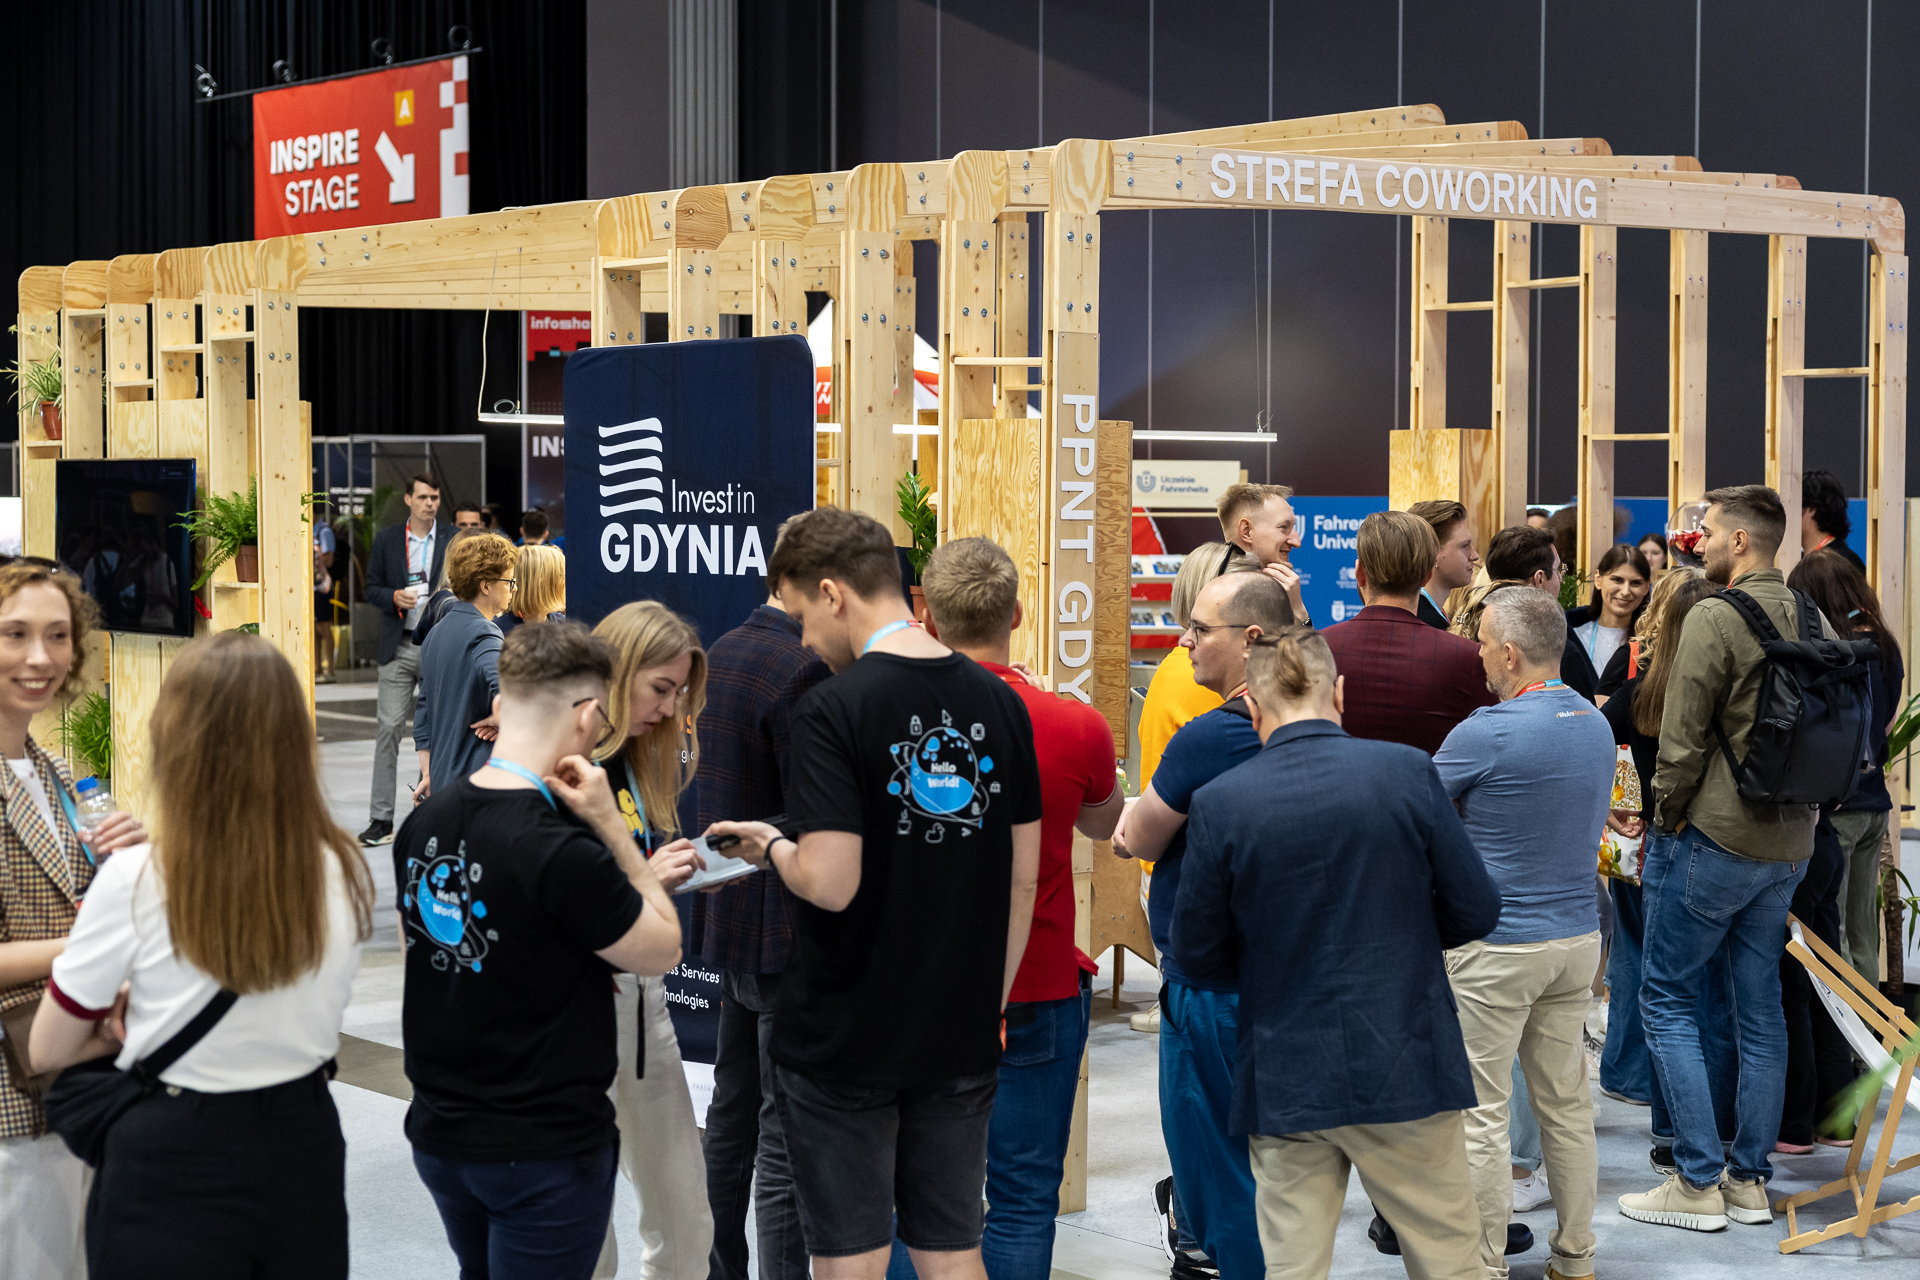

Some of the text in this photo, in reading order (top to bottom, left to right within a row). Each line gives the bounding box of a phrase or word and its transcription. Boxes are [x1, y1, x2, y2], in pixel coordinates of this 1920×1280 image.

[270, 128, 359, 175] INSPIRE
[285, 173, 359, 216] STAGE
[1210, 153, 1598, 219] STREFA COWORKING
[532, 435, 564, 457] IN
[672, 478, 755, 514] Invest in
[1060, 394, 1096, 564] PPNT
[600, 522, 768, 577] GDYNIA
[927, 777, 960, 789] World!
[931, 761, 957, 773] Hello
[681, 963, 720, 984] Services
[664, 985, 709, 1010] hnologies
